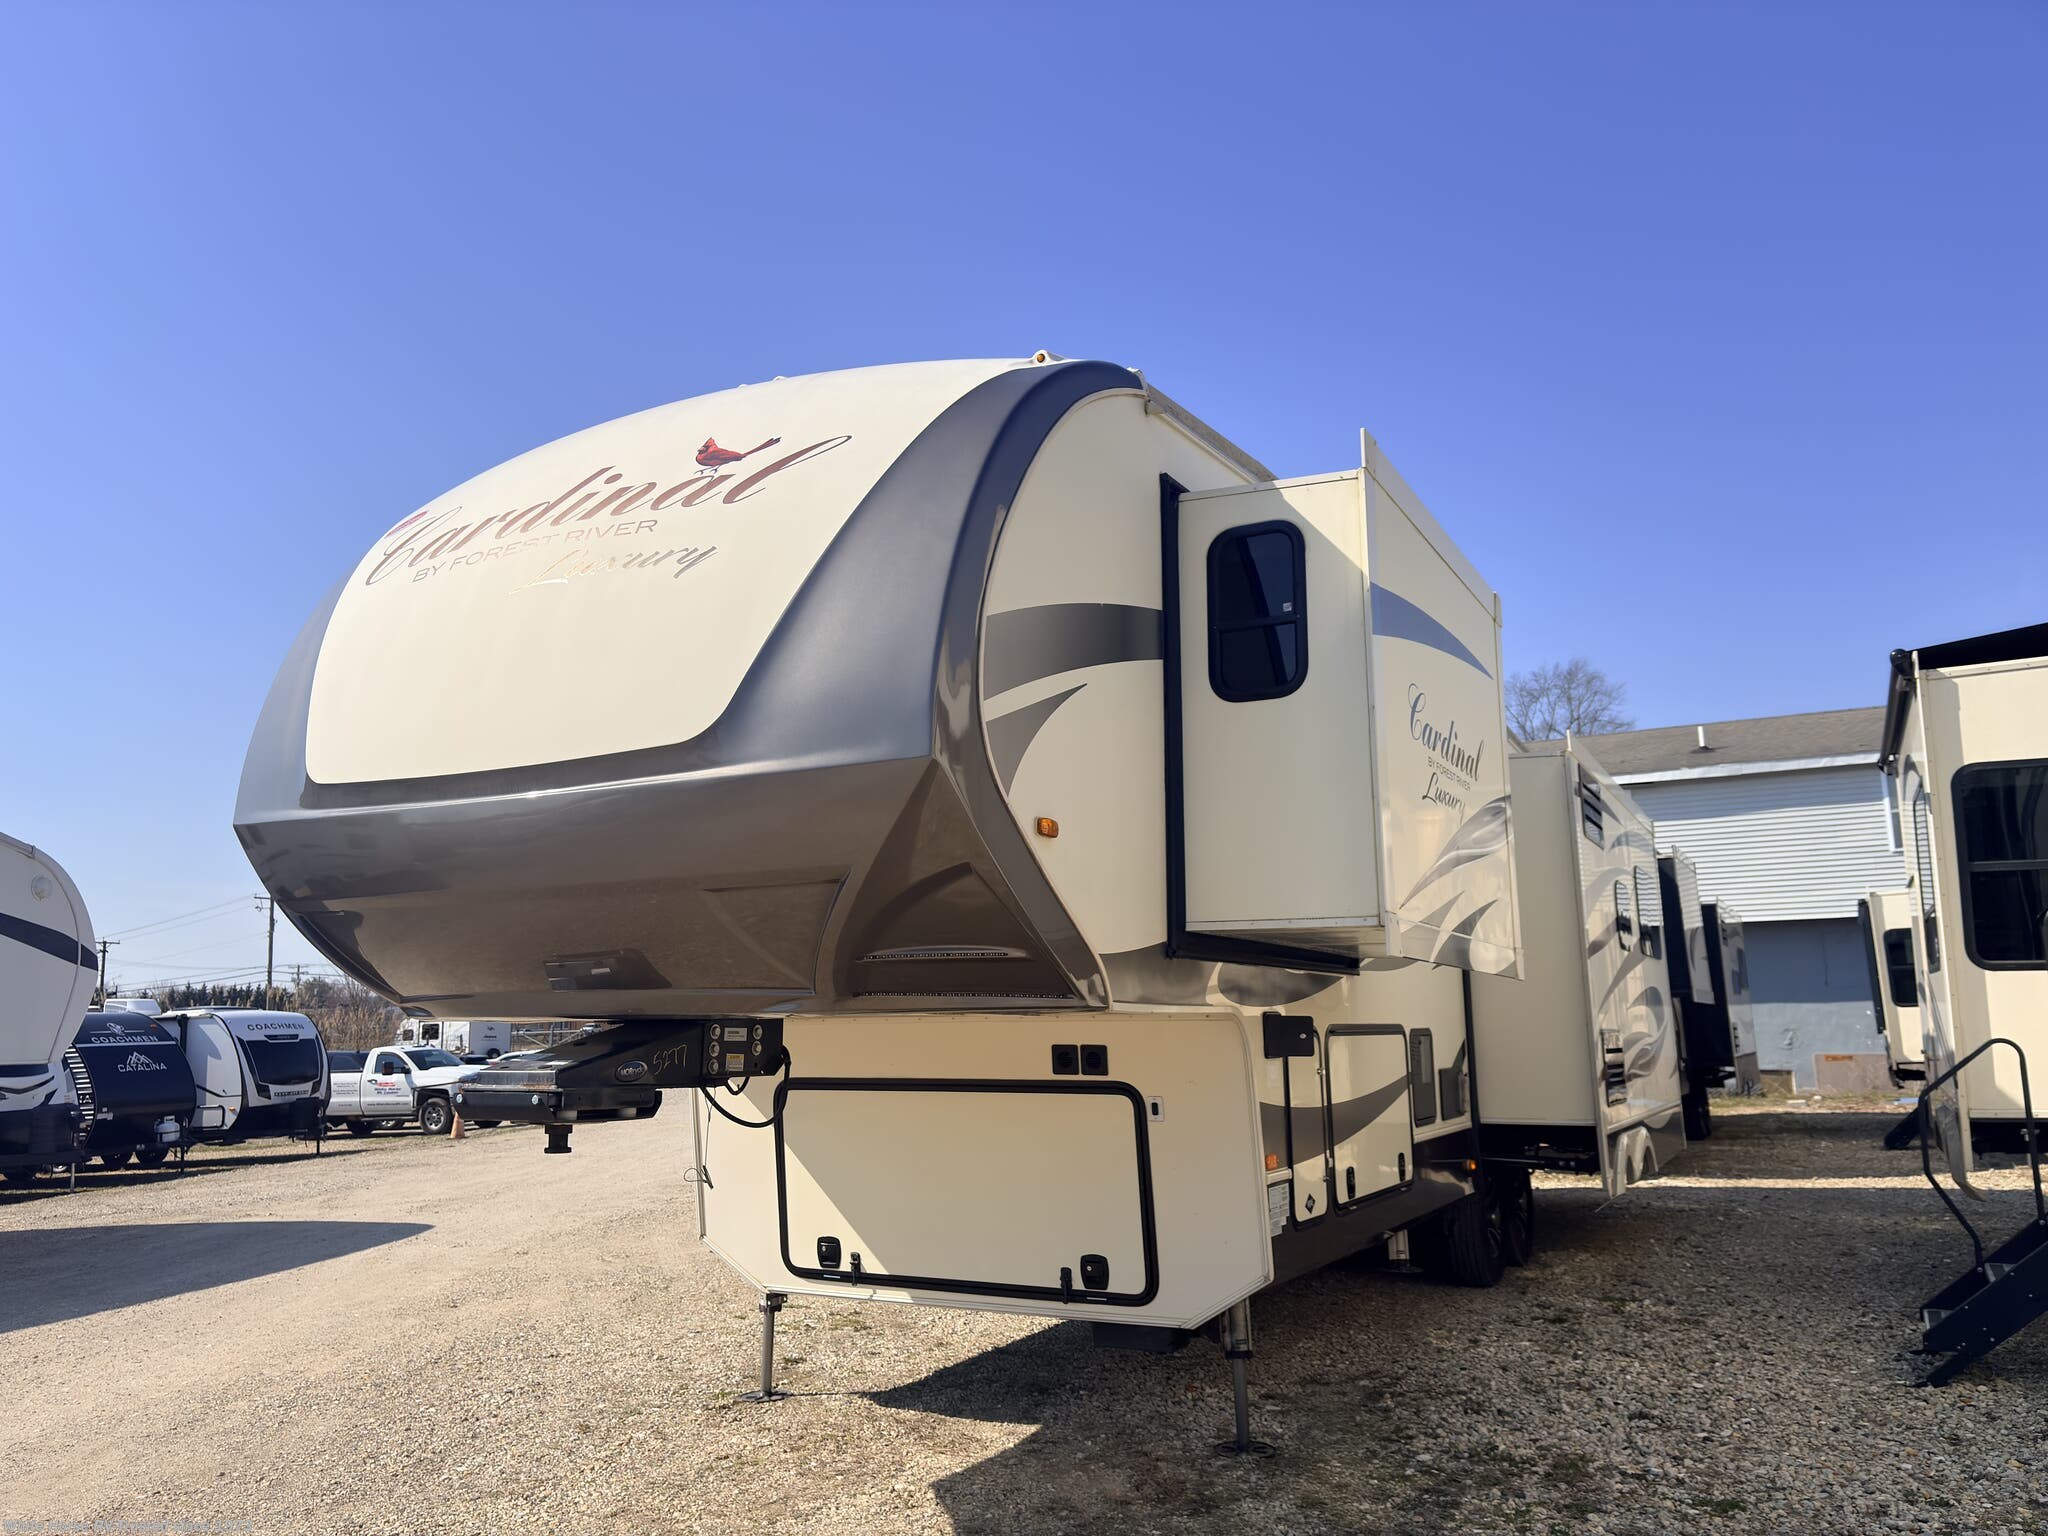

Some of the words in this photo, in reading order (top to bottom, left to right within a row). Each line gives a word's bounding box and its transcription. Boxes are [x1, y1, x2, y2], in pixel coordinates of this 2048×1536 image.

[365, 435, 853, 586] Cardinal
[412, 562, 447, 583] BY
[448, 534, 559, 571] FOREST
[563, 519, 658, 544] RIVER
[509, 546, 719, 594] Luxury
[1408, 683, 1485, 782] Cardinal
[1422, 772, 1466, 826] Luxury
[91, 1035, 159, 1044] COACHMEN
[247, 1023, 305, 1031] COACHMEN
[118, 1062, 167, 1072] CATALINA
[653, 1043, 688, 1076] 5277
